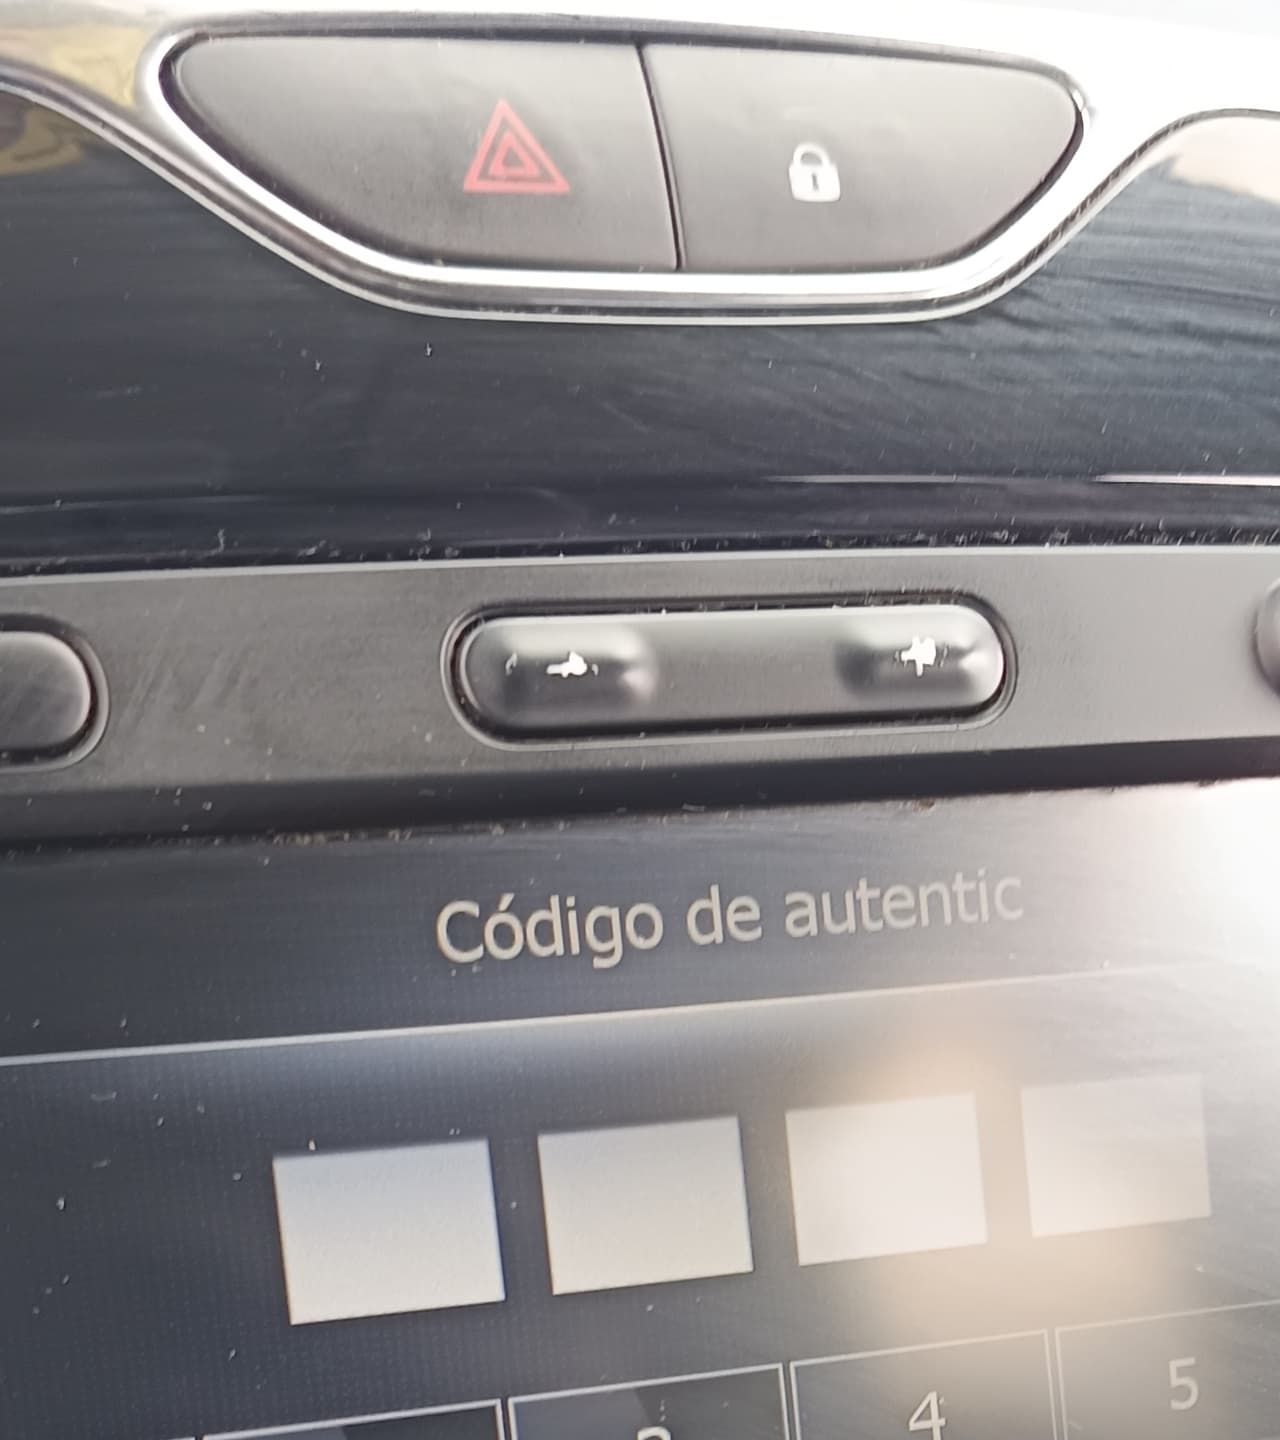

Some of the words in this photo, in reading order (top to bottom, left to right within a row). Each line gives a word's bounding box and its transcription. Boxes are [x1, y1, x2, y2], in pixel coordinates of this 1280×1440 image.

[436, 890, 665, 975] Código
[686, 885, 762, 945] de
[785, 869, 1024, 942] autentic
[1168, 1357, 1200, 1412] 5
